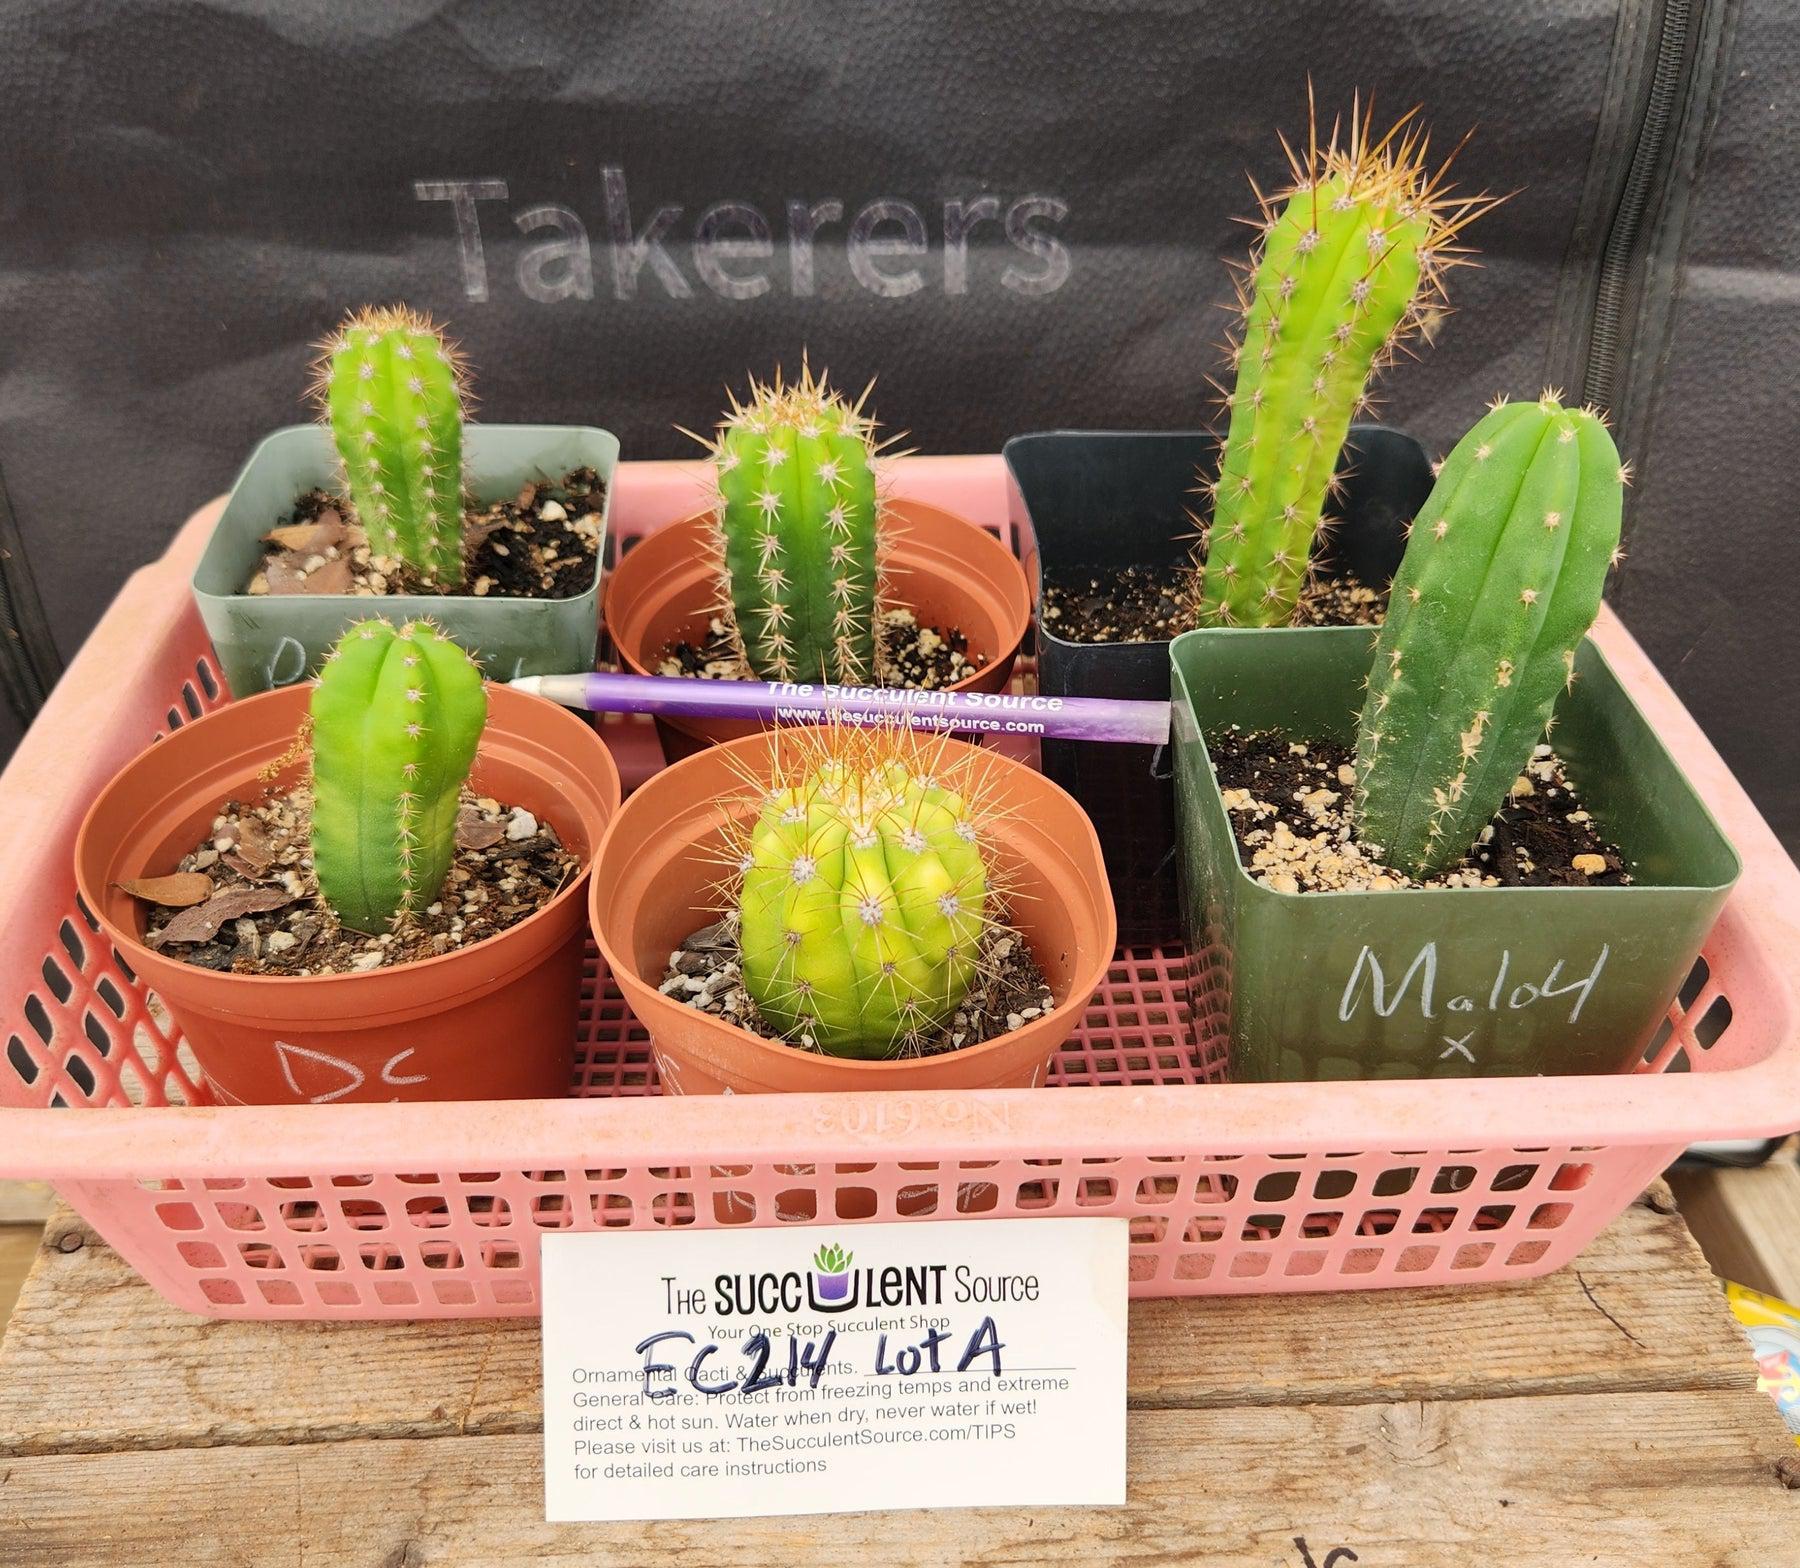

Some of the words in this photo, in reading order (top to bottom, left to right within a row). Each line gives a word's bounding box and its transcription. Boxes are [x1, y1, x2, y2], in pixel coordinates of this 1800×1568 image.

[413, 167, 1072, 302] Takerers
[767, 681, 814, 698] The
[822, 684, 957, 706] Succulent
[965, 692, 1063, 711] Source
[778, 707, 1045, 733] www.thesuccuentsource.com
[955, 1265, 1039, 1303] Source
[708, 1325, 744, 1340] Your
[749, 1324, 782, 1338] One
[787, 1322, 823, 1340] Stop
[828, 1316, 905, 1334] Succulent
[910, 1315, 950, 1331] Shop
[957, 1316, 1006, 1377] A
[572, 1366, 677, 1384] Ornamental
[684, 1366, 729, 1382] Cacti
[736, 1365, 749, 1381] &
[757, 1361, 857, 1380] Succuents.
[573, 1390, 644, 1407] General
[652, 1390, 699, 1406] Care:
[707, 1387, 770, 1405] Protect
[775, 1387, 815, 1403] from
[821, 1381, 892, 1400] freezing
[898, 1380, 952, 1397] temps
[958, 1377, 991, 1392] and
[997, 1377, 1069, 1392] extreme
[573, 1415, 623, 1431] direct
[629, 1414, 641, 1430] &
[648, 1414, 676, 1430] hot
[682, 1417, 718, 1429] sun.
[725, 1413, 778, 1428] Water
[784, 1410, 832, 1426] when
[838, 1406, 869, 1425] dry,
[876, 1404, 925, 1419] never
[931, 1402, 980, 1418] water
[985, 1400, 997, 1416] if
[1001, 1399, 1037, 1415] wet!
[574, 1439, 635, 1455] Please
[641, 1438, 677, 1453] visit
[682, 1441, 703, 1453] us
[710, 1438, 730, 1453] at:
[737, 1423, 1016, 1451] TheSucculentSource.com/TIPS
[574, 1463, 598, 1479] for
[604, 1461, 674, 1478] detailed
[680, 1464, 719, 1477] care
[725, 1458, 827, 1476] instructions
